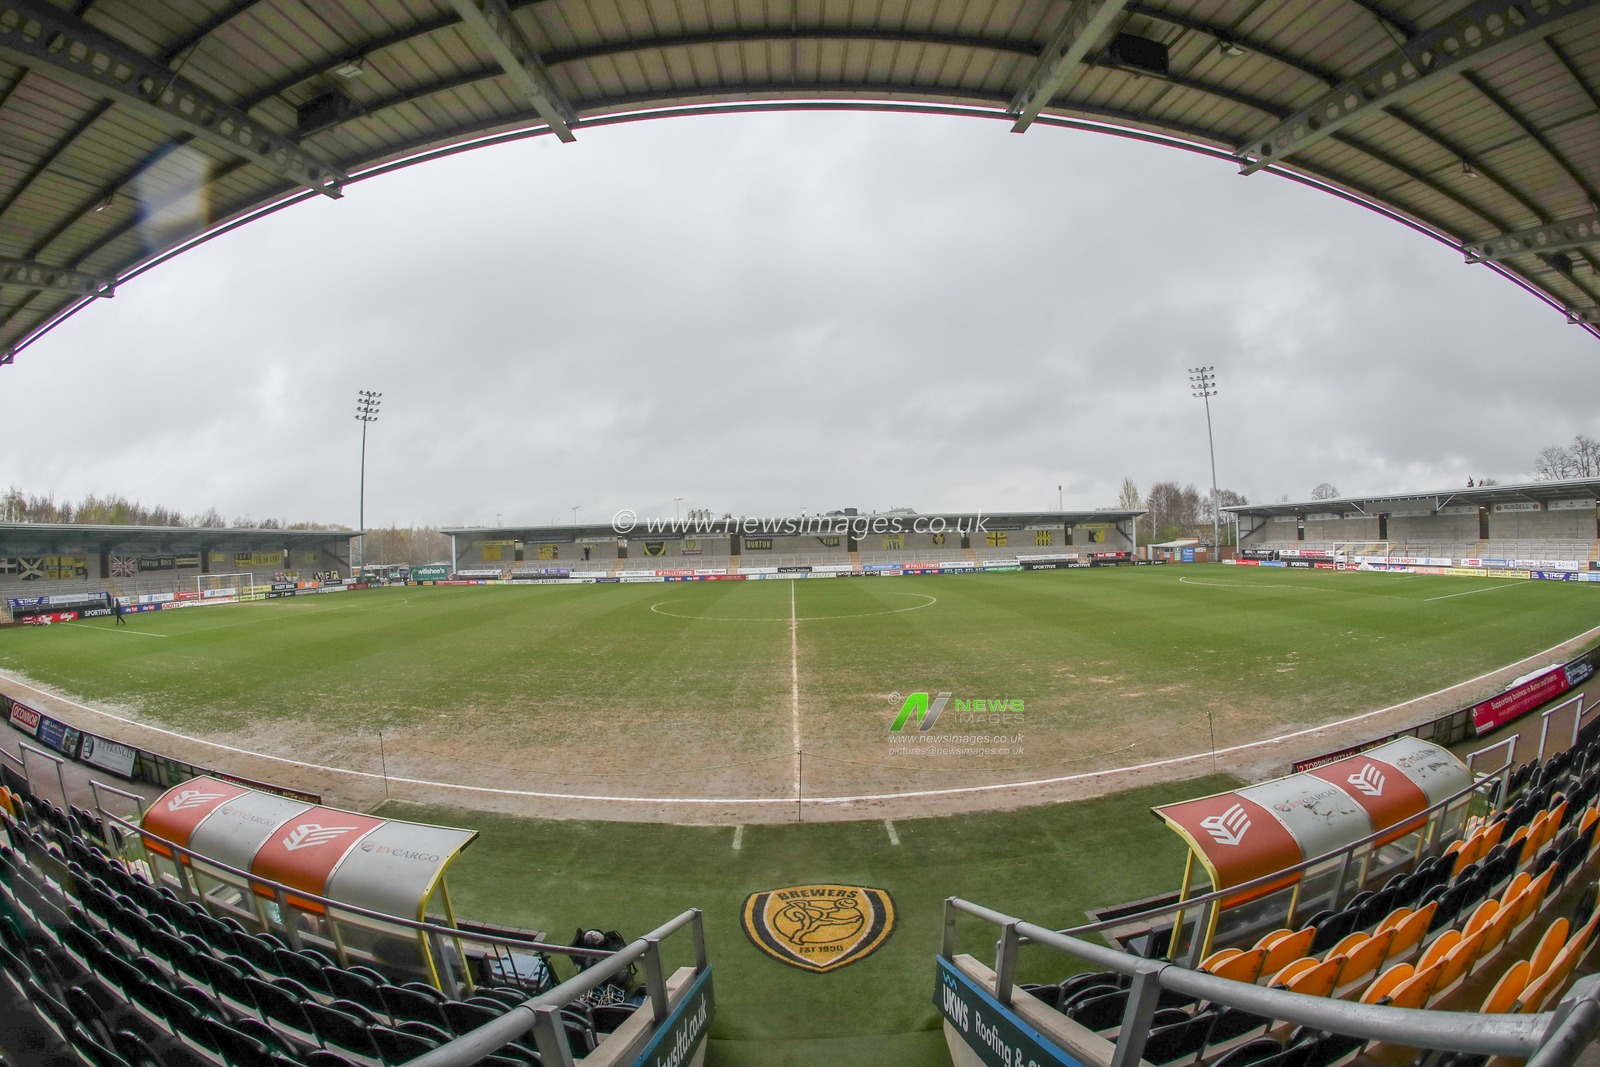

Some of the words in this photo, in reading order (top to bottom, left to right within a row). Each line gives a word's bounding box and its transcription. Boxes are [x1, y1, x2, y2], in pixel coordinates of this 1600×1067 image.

[1503, 503, 1530, 511] RUSSELL
[746, 540, 771, 549] BURTON
[85, 608, 112, 617] SPORTFIVE
[1490, 695, 1513, 711] Supporting
[1512, 688, 1528, 700] business
[1530, 682, 1541, 692] Burton
[106, 741, 134, 760] FRANCIS
[776, 889, 859, 901] BREWERS
[798, 946, 817, 954] EST
[942, 983, 969, 1034] UKWS
[975, 1009, 1012, 1067] Roofing
